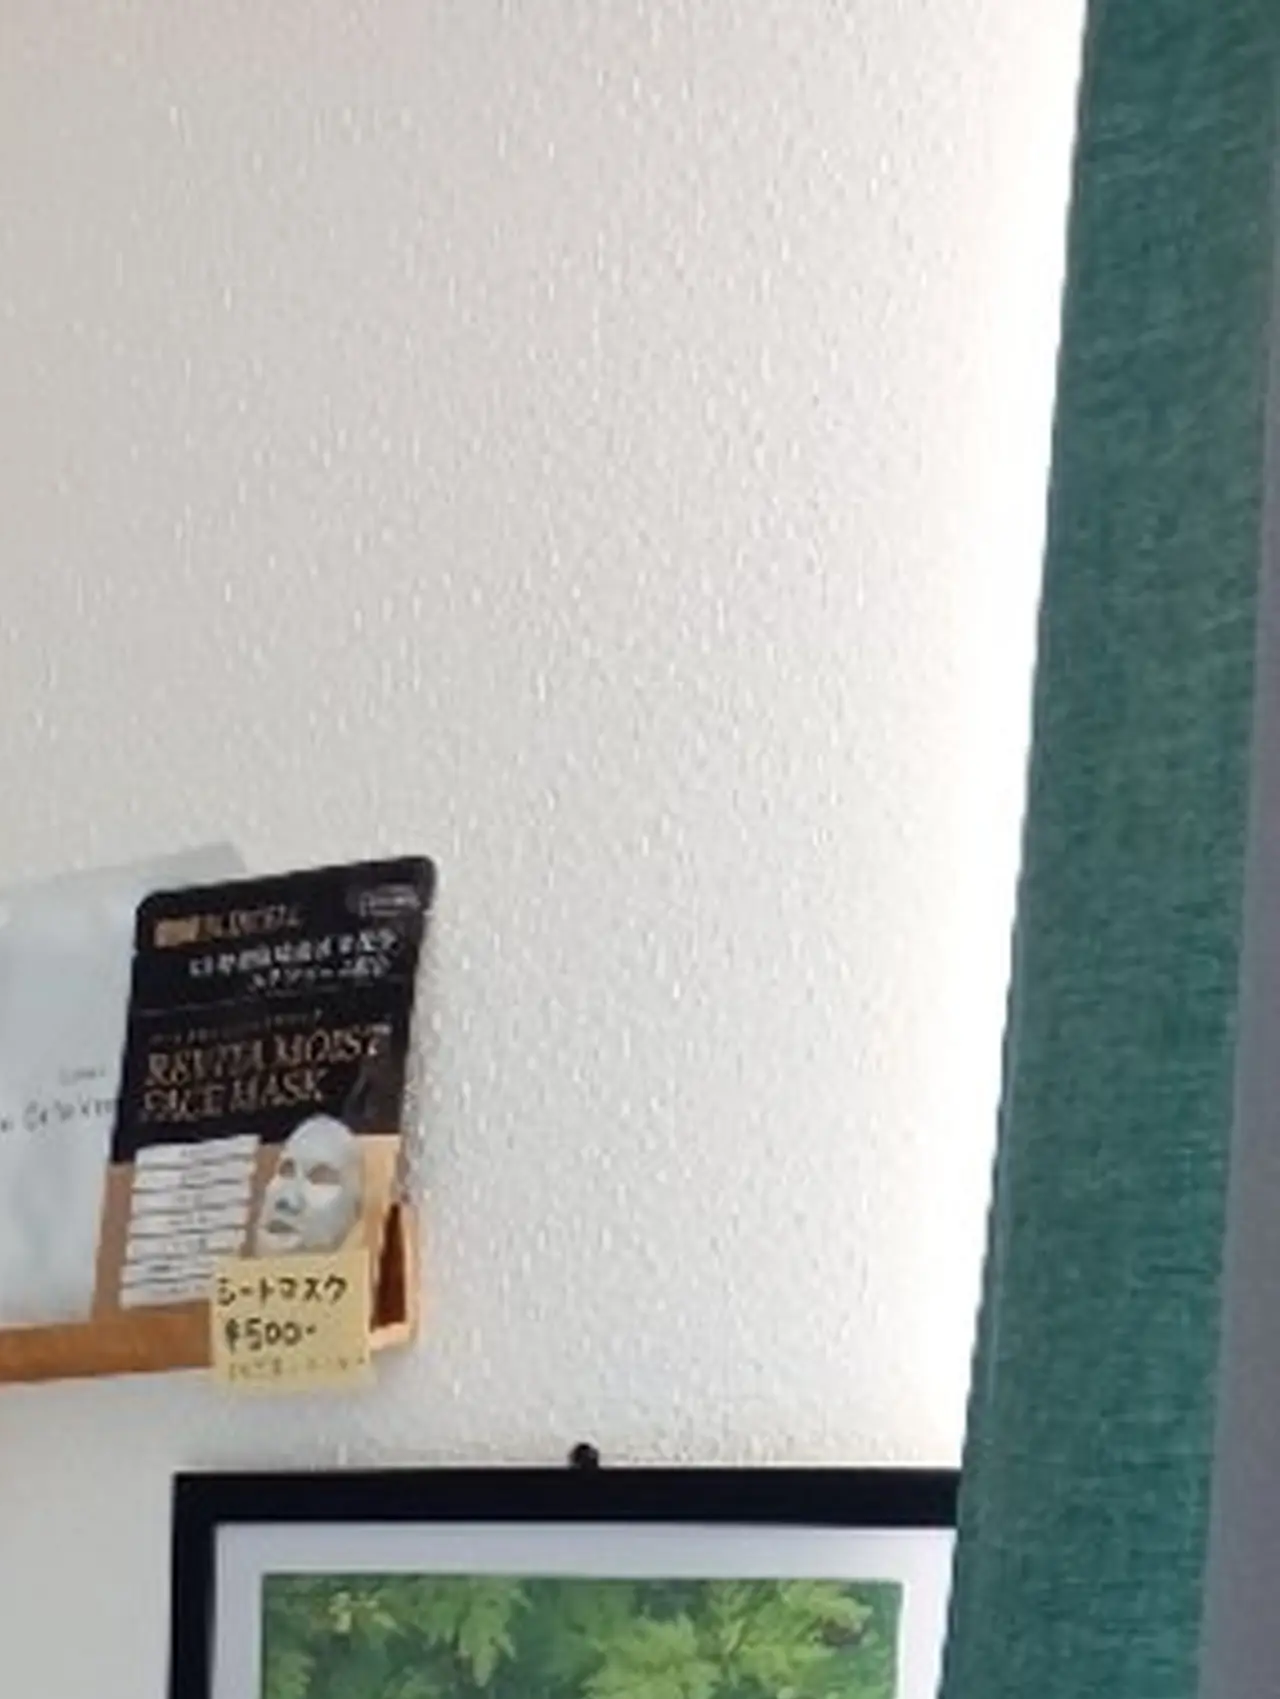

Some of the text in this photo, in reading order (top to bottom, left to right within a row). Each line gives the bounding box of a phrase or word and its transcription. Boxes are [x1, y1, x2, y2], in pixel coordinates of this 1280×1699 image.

[272, 1022, 393, 1067] MOIST
[142, 1082, 225, 1122] FACE
[229, 1068, 328, 1113] MASK
[216, 1274, 348, 1308] シートマスク
